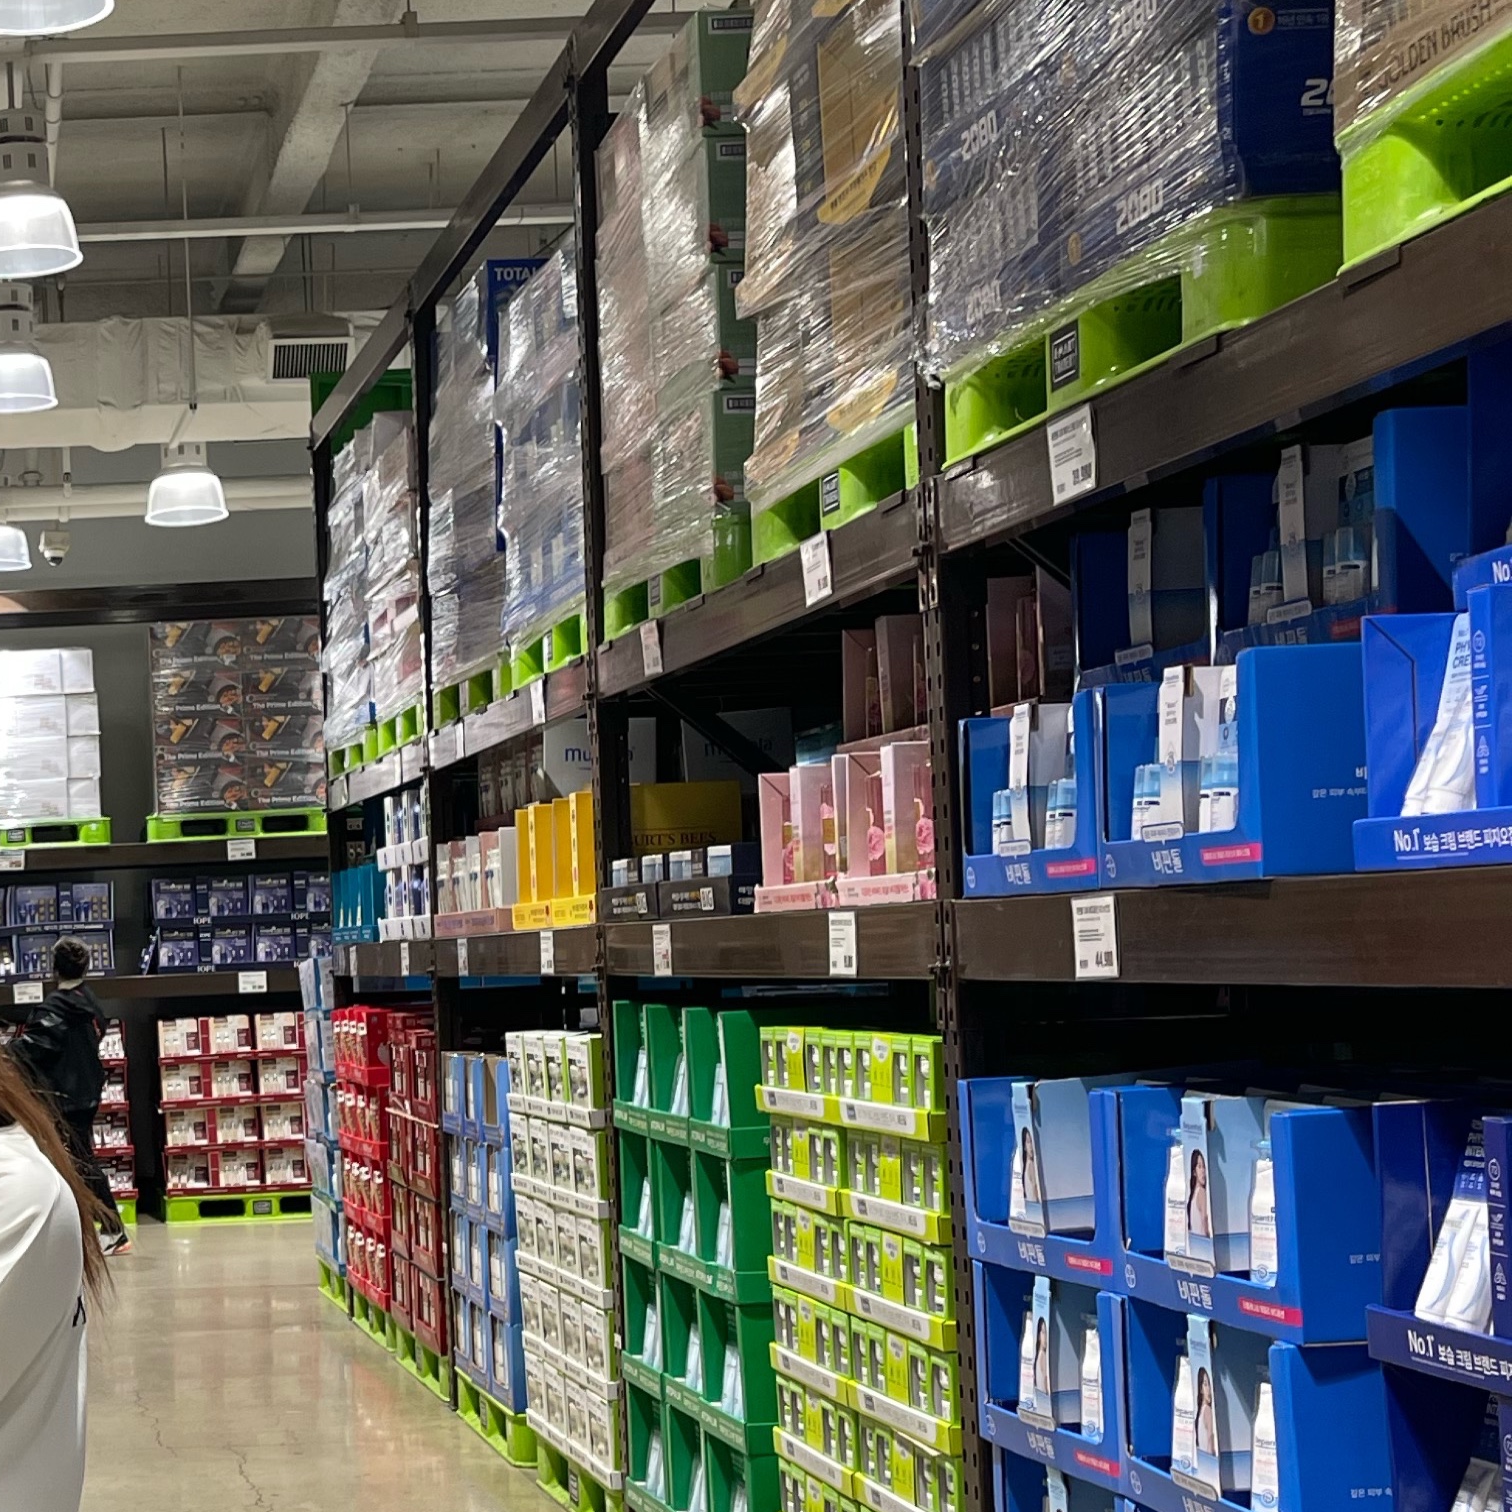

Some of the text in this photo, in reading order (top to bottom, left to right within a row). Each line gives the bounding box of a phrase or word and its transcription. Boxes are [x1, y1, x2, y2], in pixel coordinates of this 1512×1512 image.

[960, 110, 999, 161] 2080
[1116, 178, 1164, 235] 2080
[284, 651, 308, 659] Edition
[288, 700, 312, 708] Edition
[680, 830, 717, 846] BEES
[1424, 831, 1439, 853] 보습
[1440, 830, 1457, 850] 크림
[1457, 829, 1482, 850] 브랜드
[1005, 862, 1032, 885] 비판톨
[1152, 849, 1184, 875] 비판톨
[193, 916, 212, 924] IOPE
[291, 912, 310, 920] IOPE
[197, 964, 216, 972] IOPE
[1018, 1240, 1046, 1267] 비판톨
[1177, 1279, 1214, 1310] 비판톨
[1438, 1343, 1455, 1366] 보습
[1456, 1349, 1473, 1370] 크림
[1473, 1353, 1499, 1376] 브랜드
[1026, 1431, 1055, 1460] 비판톨
[1351, 1488, 1365, 1498] 깊은
[1367, 1487, 1382, 1498] 피부
